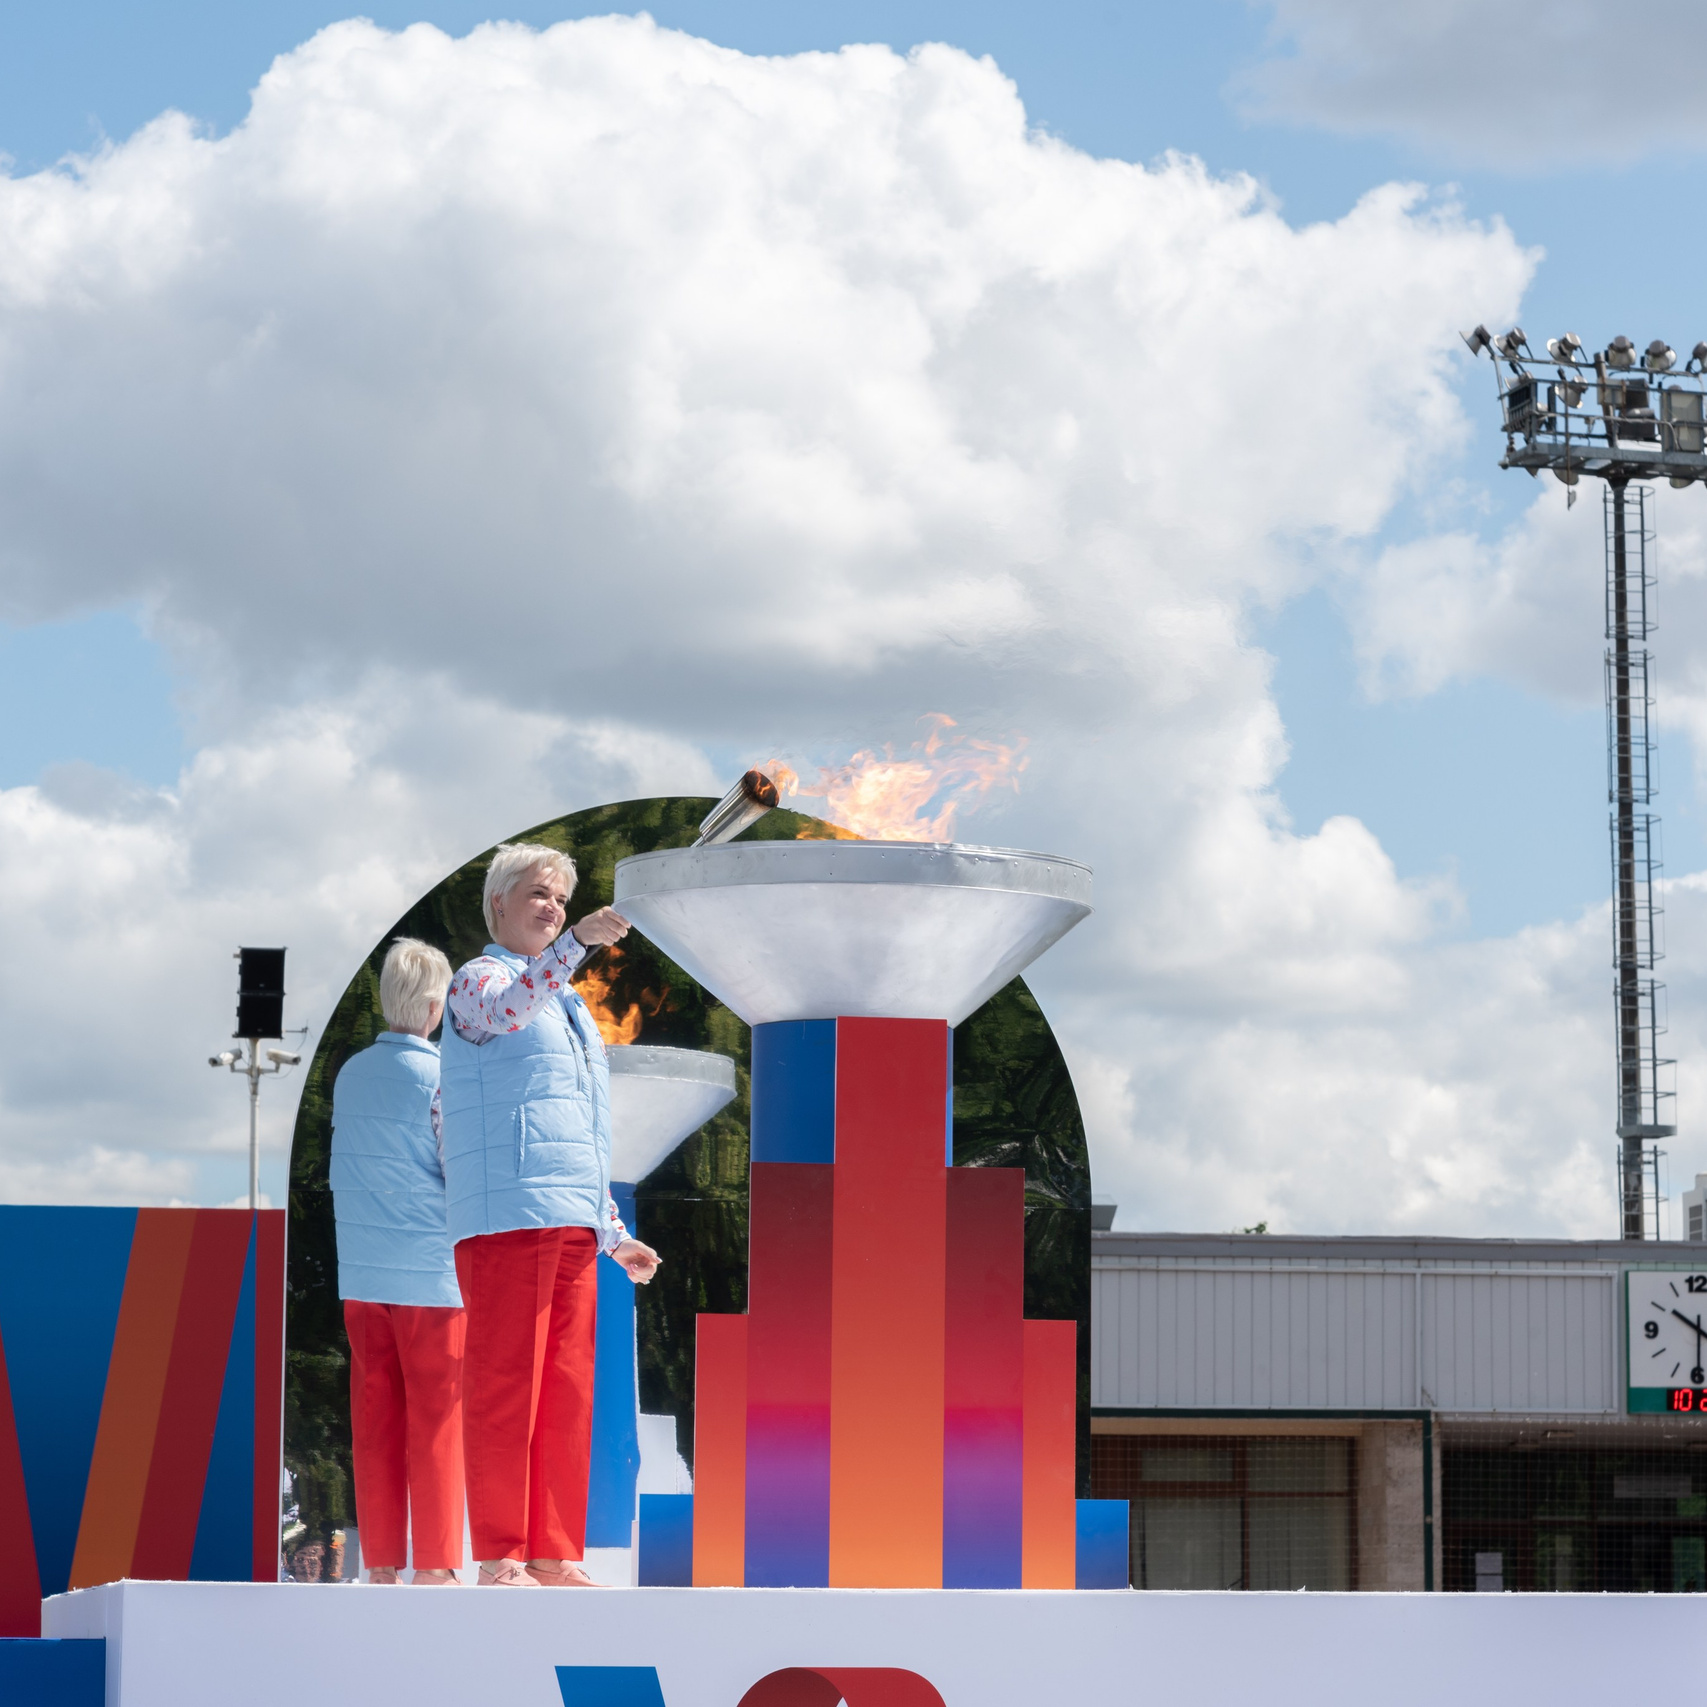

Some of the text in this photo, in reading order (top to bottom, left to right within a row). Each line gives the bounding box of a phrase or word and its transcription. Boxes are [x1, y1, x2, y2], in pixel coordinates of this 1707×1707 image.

[1685, 1275, 1707, 1293] 12
[1644, 1321, 1659, 1339] 9
[1690, 1366, 1705, 1384] 6
[1673, 1388, 1693, 1411] 10
